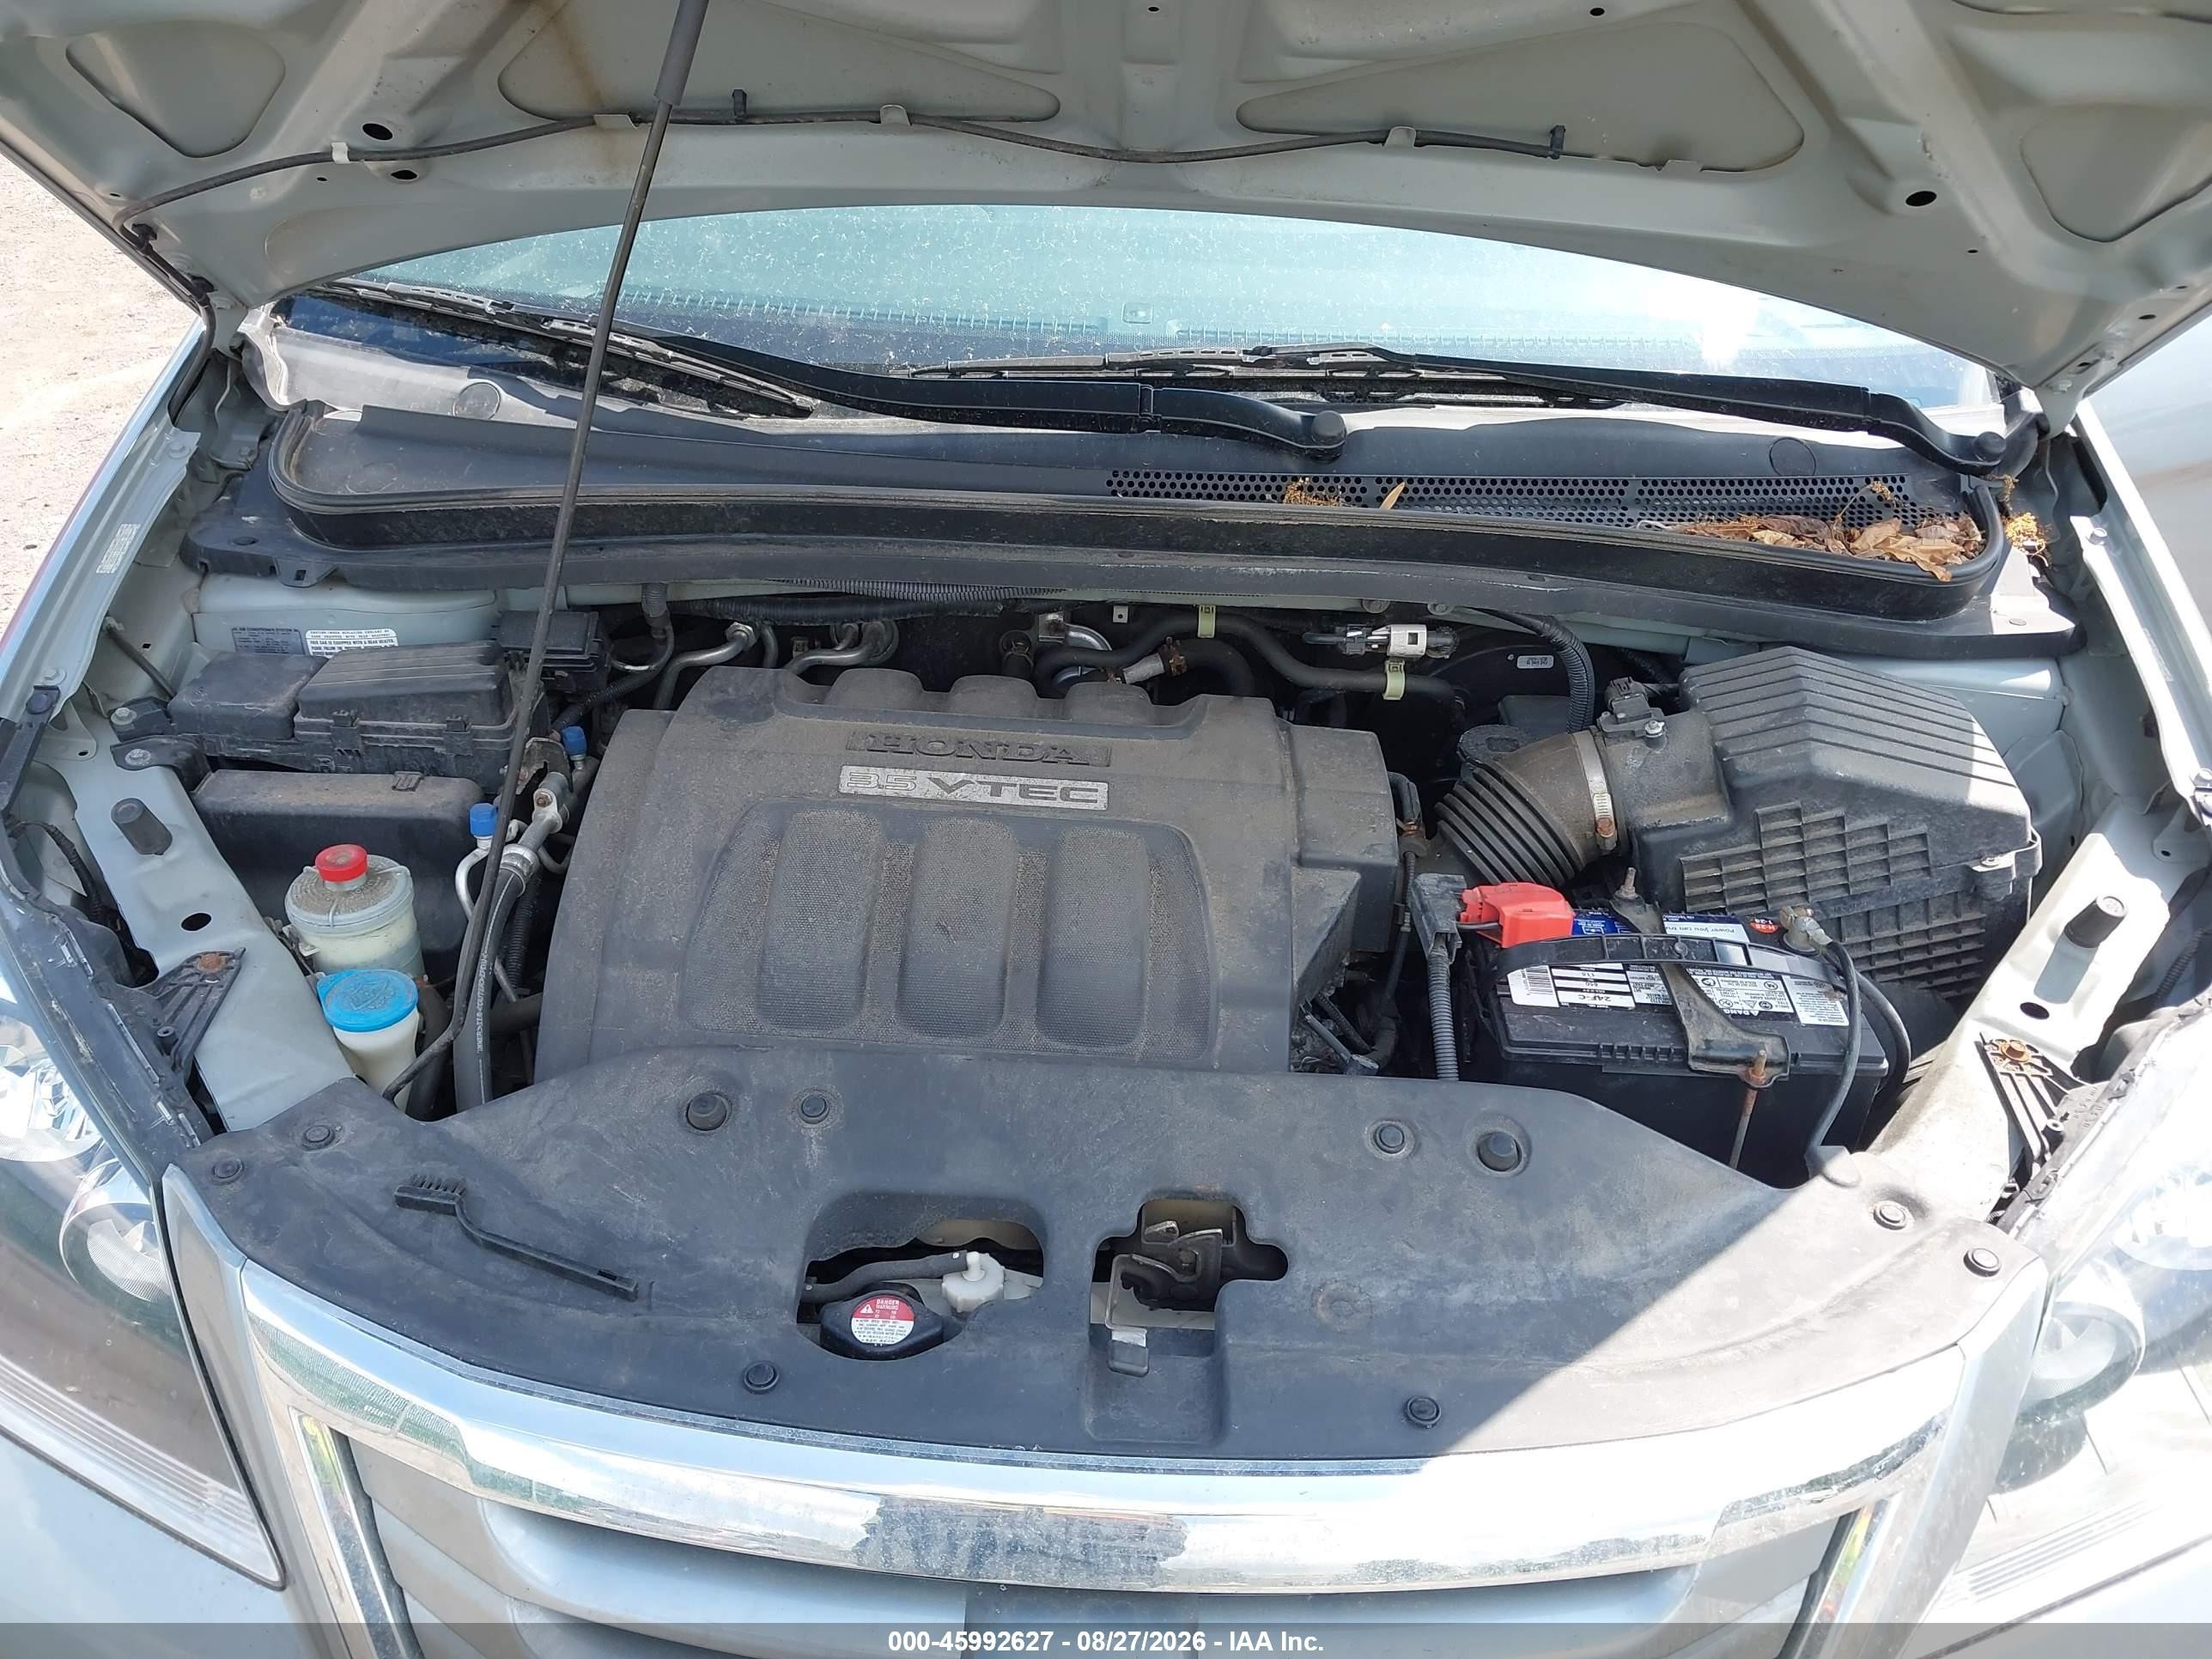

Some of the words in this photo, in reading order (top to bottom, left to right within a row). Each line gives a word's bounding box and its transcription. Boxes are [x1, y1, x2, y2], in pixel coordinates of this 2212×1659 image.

[866, 734, 1091, 765] HONDA
[846, 770, 918, 793] 3.5
[927, 775, 1099, 805] VTEC
